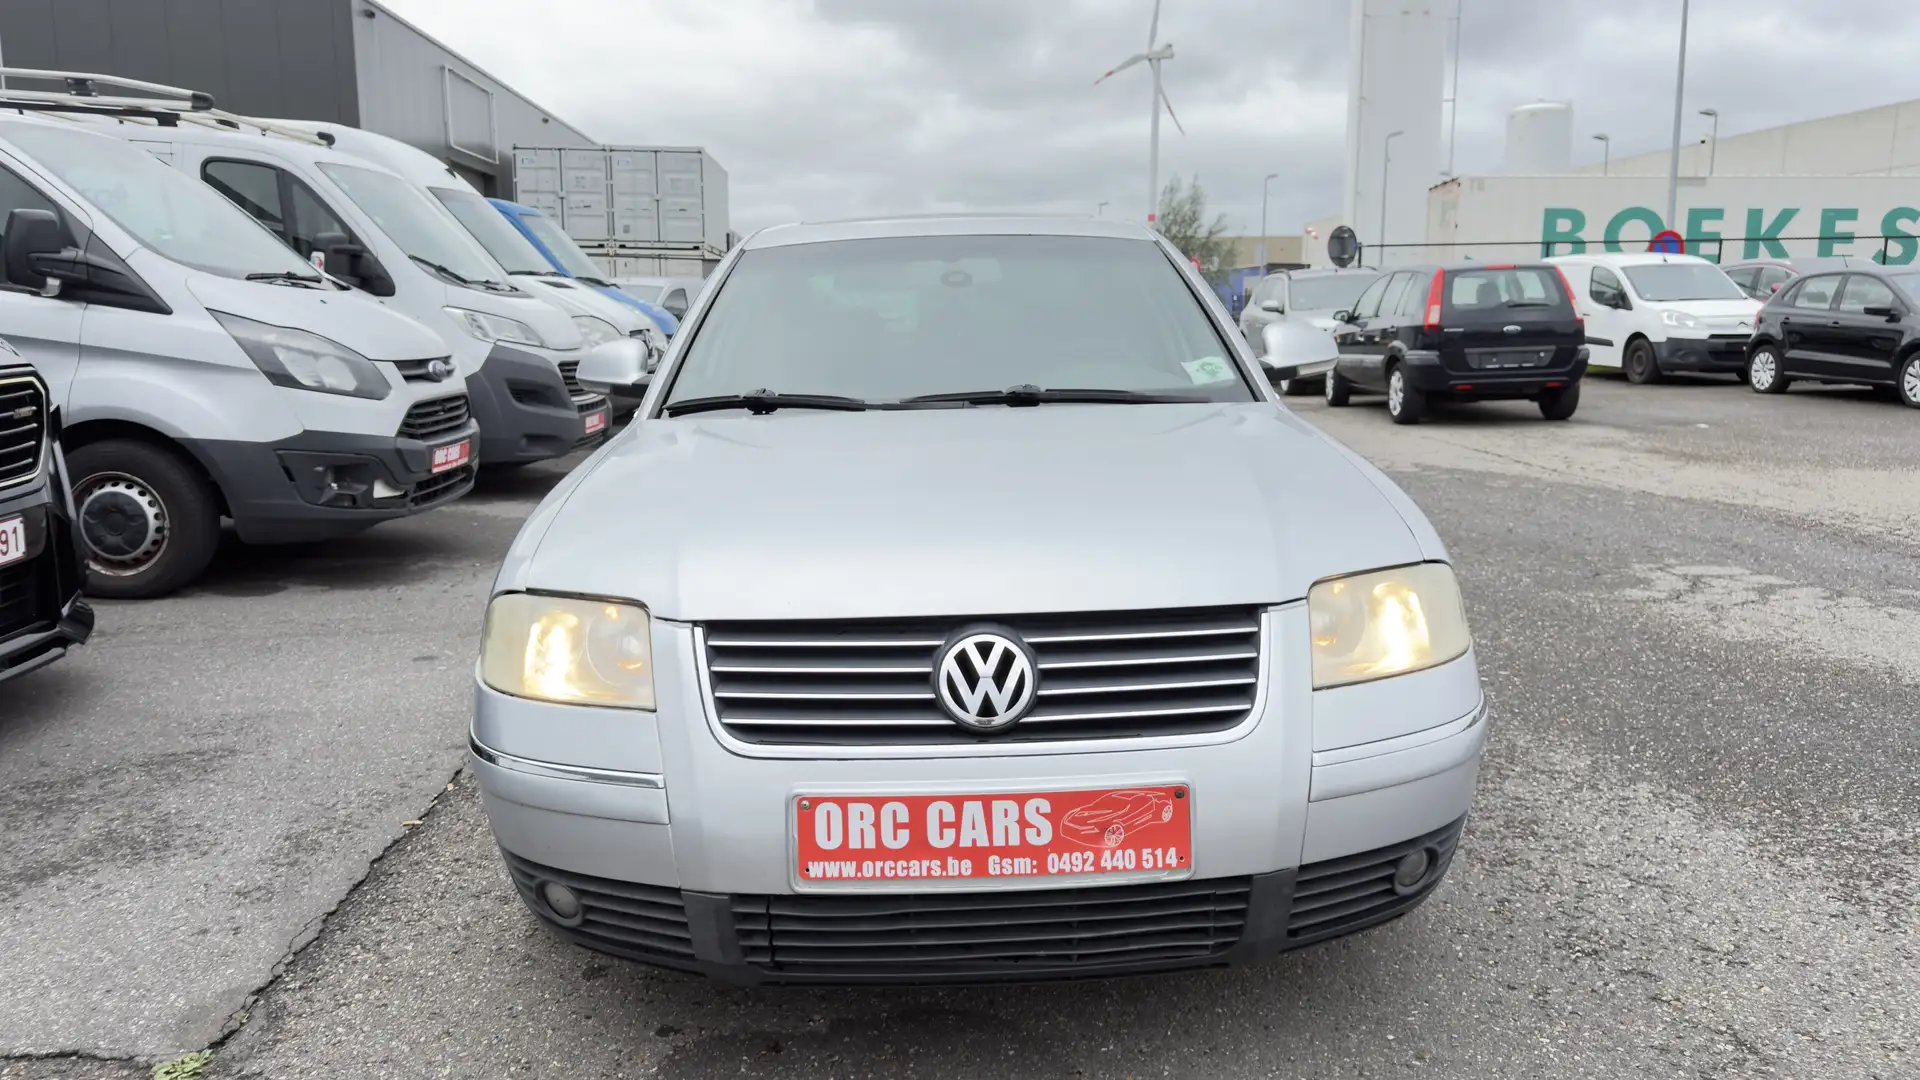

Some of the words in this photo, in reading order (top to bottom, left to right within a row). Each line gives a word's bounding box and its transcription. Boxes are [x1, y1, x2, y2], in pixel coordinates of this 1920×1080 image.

[814, 801, 910, 850] ORC
[926, 798, 1053, 849] CARS
[808, 856, 972, 878] www.orccars.be
[988, 856, 1037, 876] Gsm:
[1047, 850, 1095, 873] 0492
[1100, 848, 1136, 870] 440
[1141, 847, 1178, 869] 514
